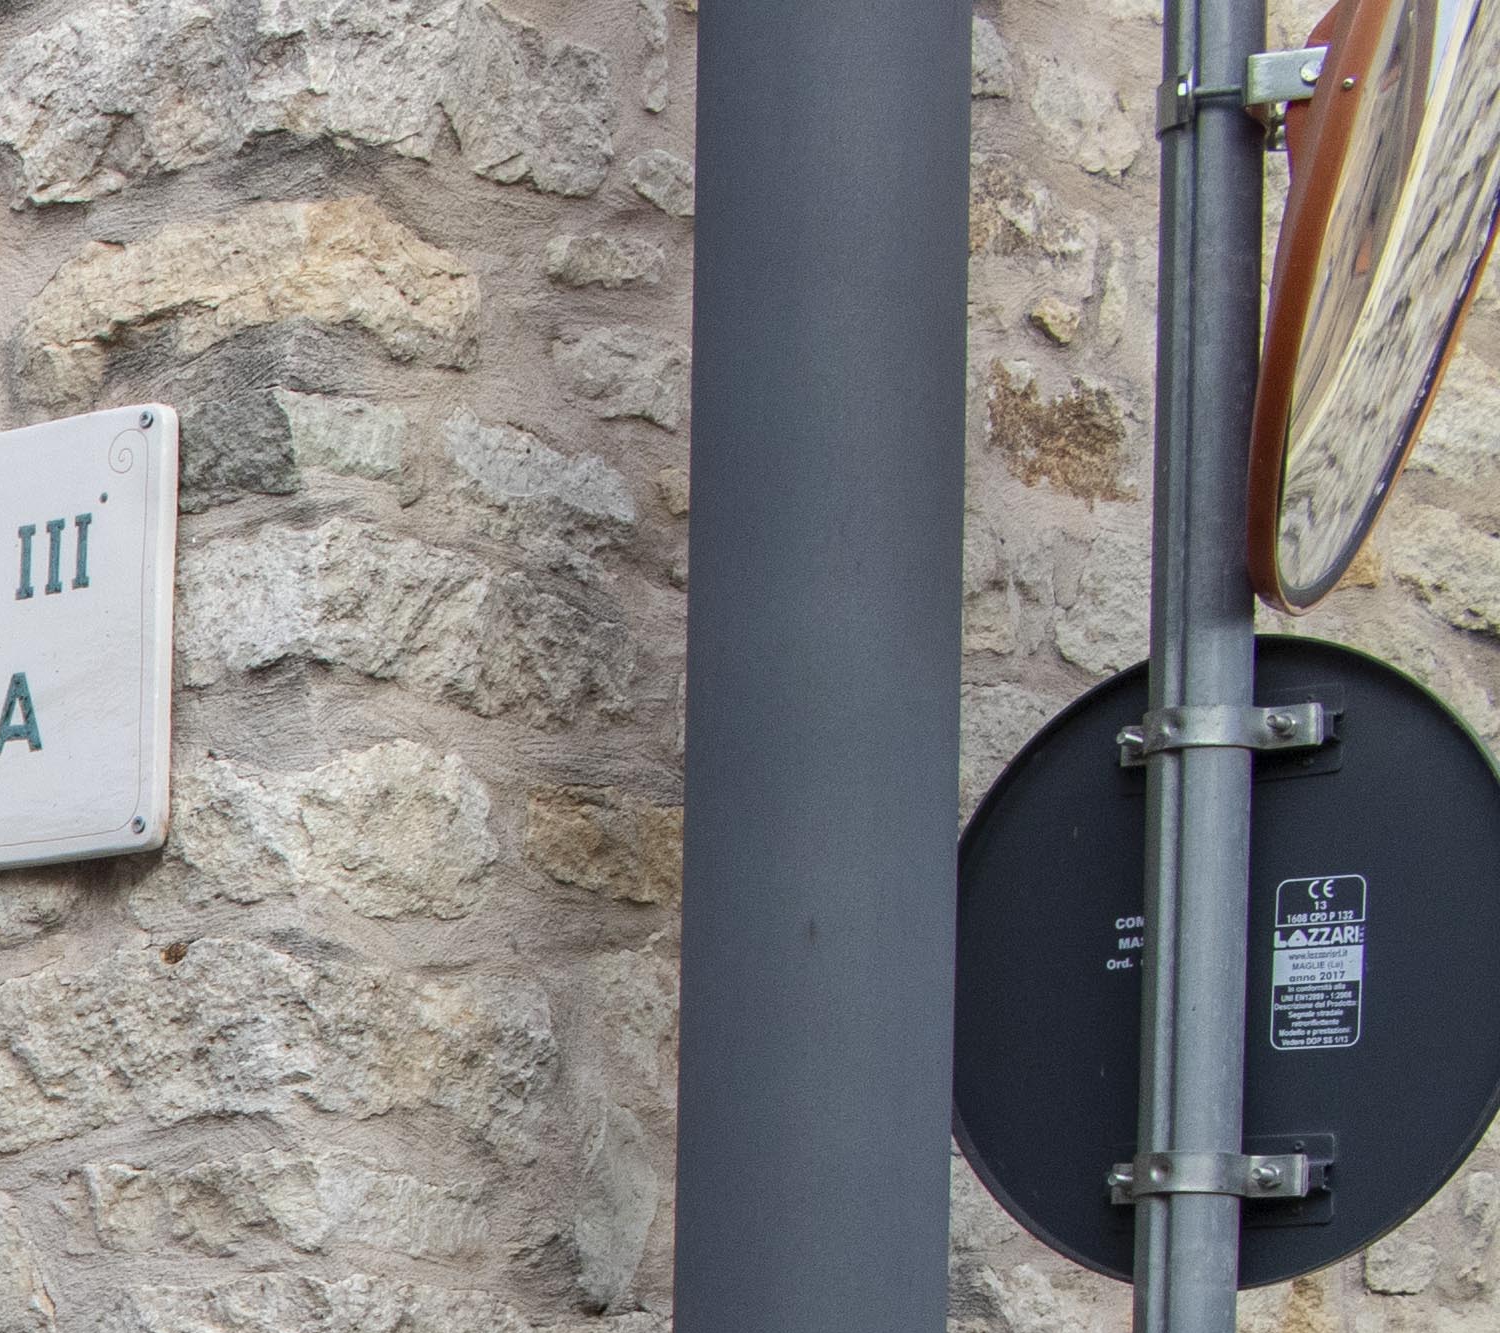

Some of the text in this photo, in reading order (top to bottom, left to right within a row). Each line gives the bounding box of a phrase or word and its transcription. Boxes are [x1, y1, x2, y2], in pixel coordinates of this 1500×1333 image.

[15, 512, 93, 600] III
[1314, 901, 1327, 910] 13
[1309, 912, 1327, 922] CPD
[1329, 911, 1336, 921] P
[1337, 910, 1354, 920] 132
[1115, 916, 1145, 930] COM
[1106, 957, 1134, 970] Ord.
[1292, 961, 1325, 970] MAGLIE
[1320, 971, 1345, 980] 2017
